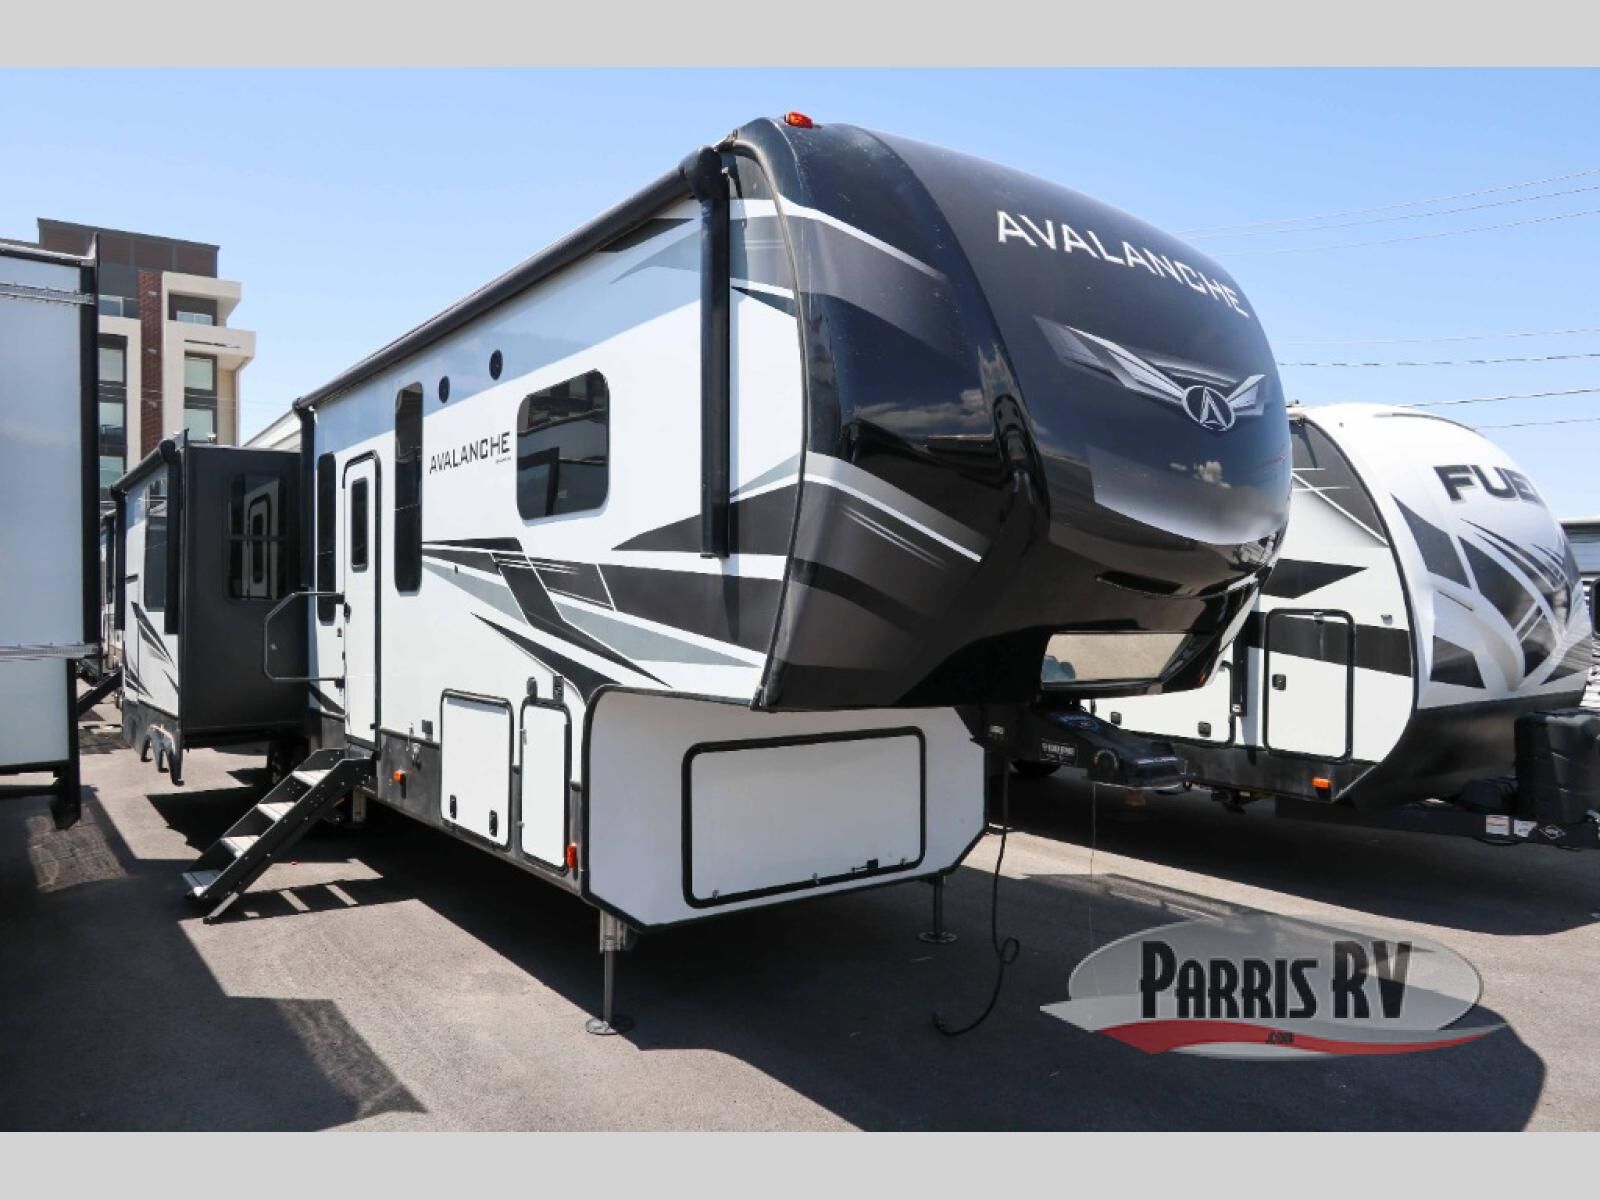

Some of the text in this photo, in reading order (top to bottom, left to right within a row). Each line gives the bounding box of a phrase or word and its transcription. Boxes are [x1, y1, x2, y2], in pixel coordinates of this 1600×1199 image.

[997, 210, 1249, 318] AVALANCHE
[429, 431, 511, 475] AVALANCHE
[1433, 464, 1546, 504] FUE
